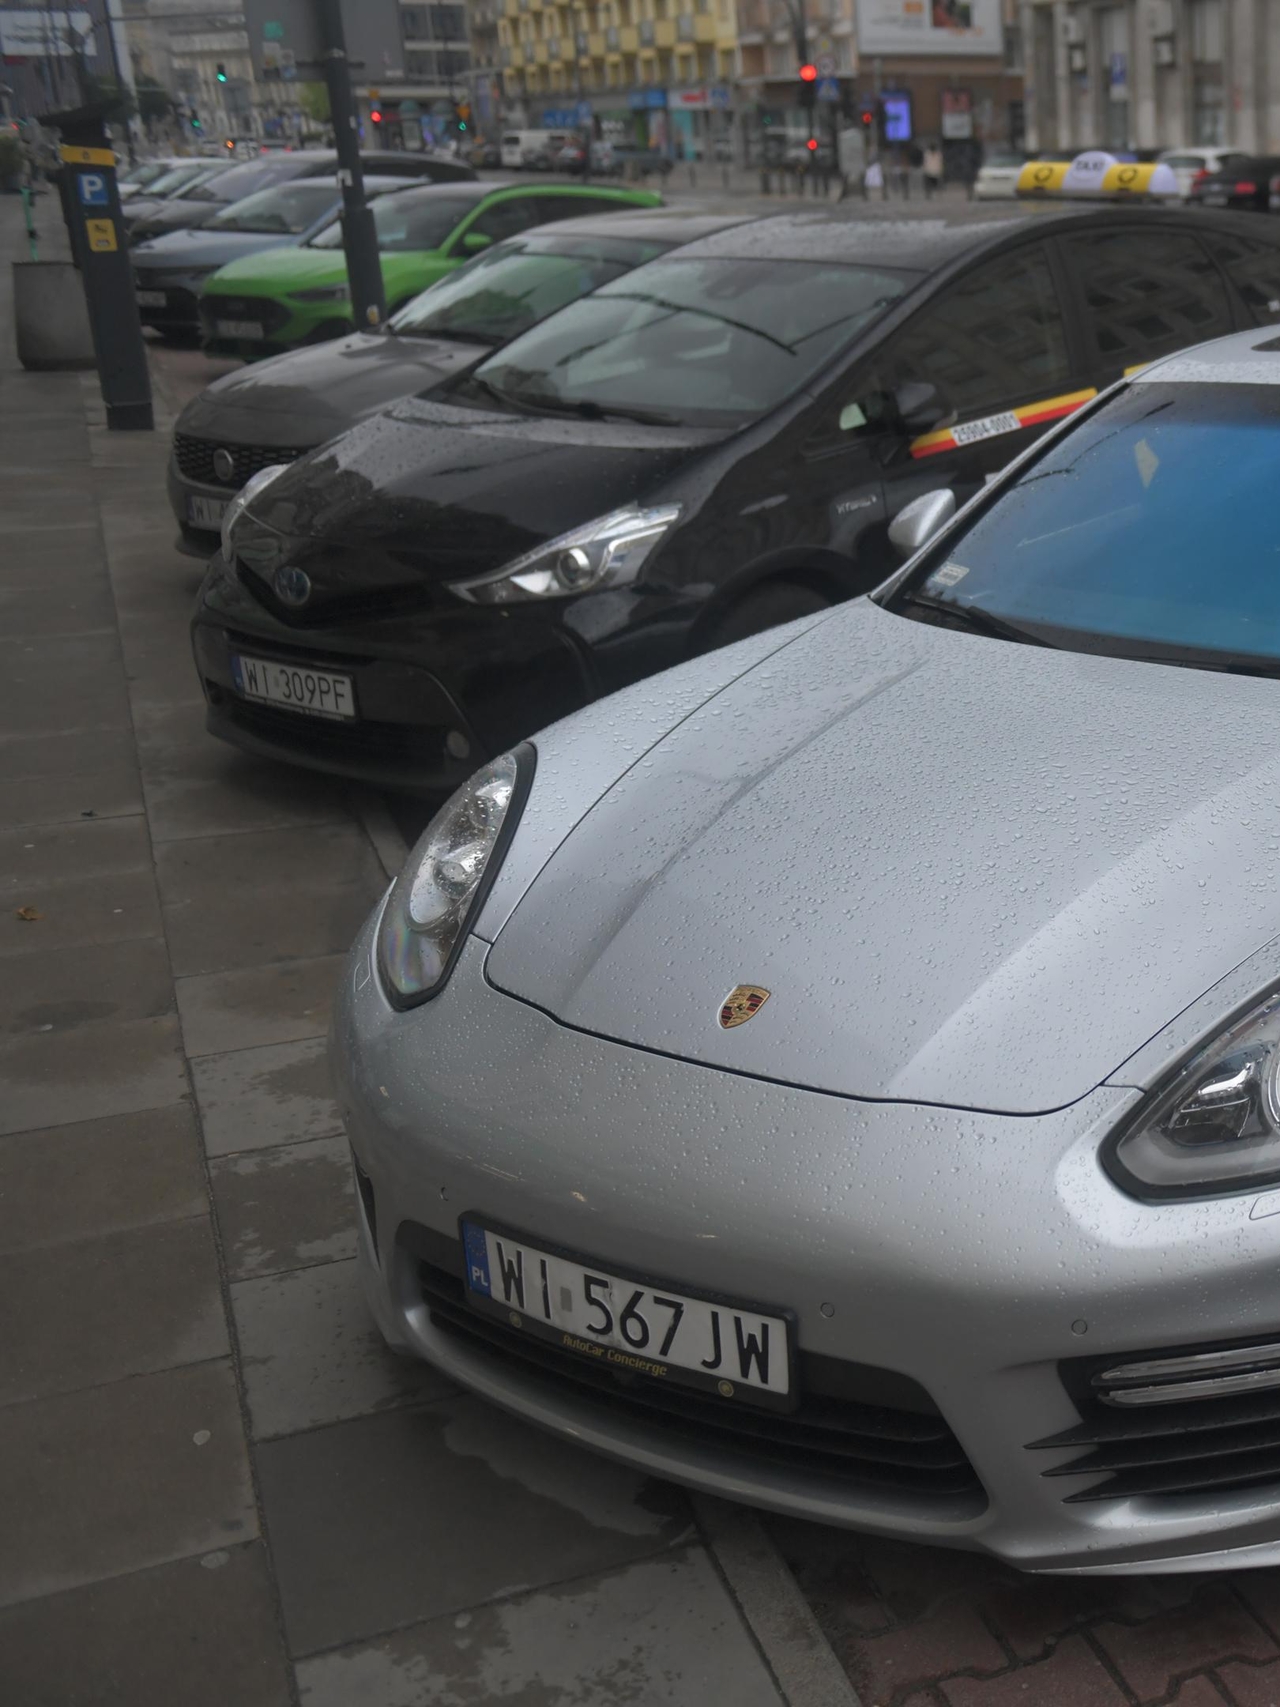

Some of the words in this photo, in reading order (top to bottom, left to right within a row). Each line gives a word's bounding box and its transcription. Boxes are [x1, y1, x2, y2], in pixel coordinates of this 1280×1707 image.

[1075, 160, 1105, 171] TAXI
[81, 175, 104, 200] P
[244, 661, 269, 695] WI
[280, 669, 345, 710] 309PF
[471, 1266, 489, 1288] PL
[496, 1241, 552, 1321] WI
[563, 1334, 605, 1357] AutoCar
[606, 1349, 668, 1377] Concierge
